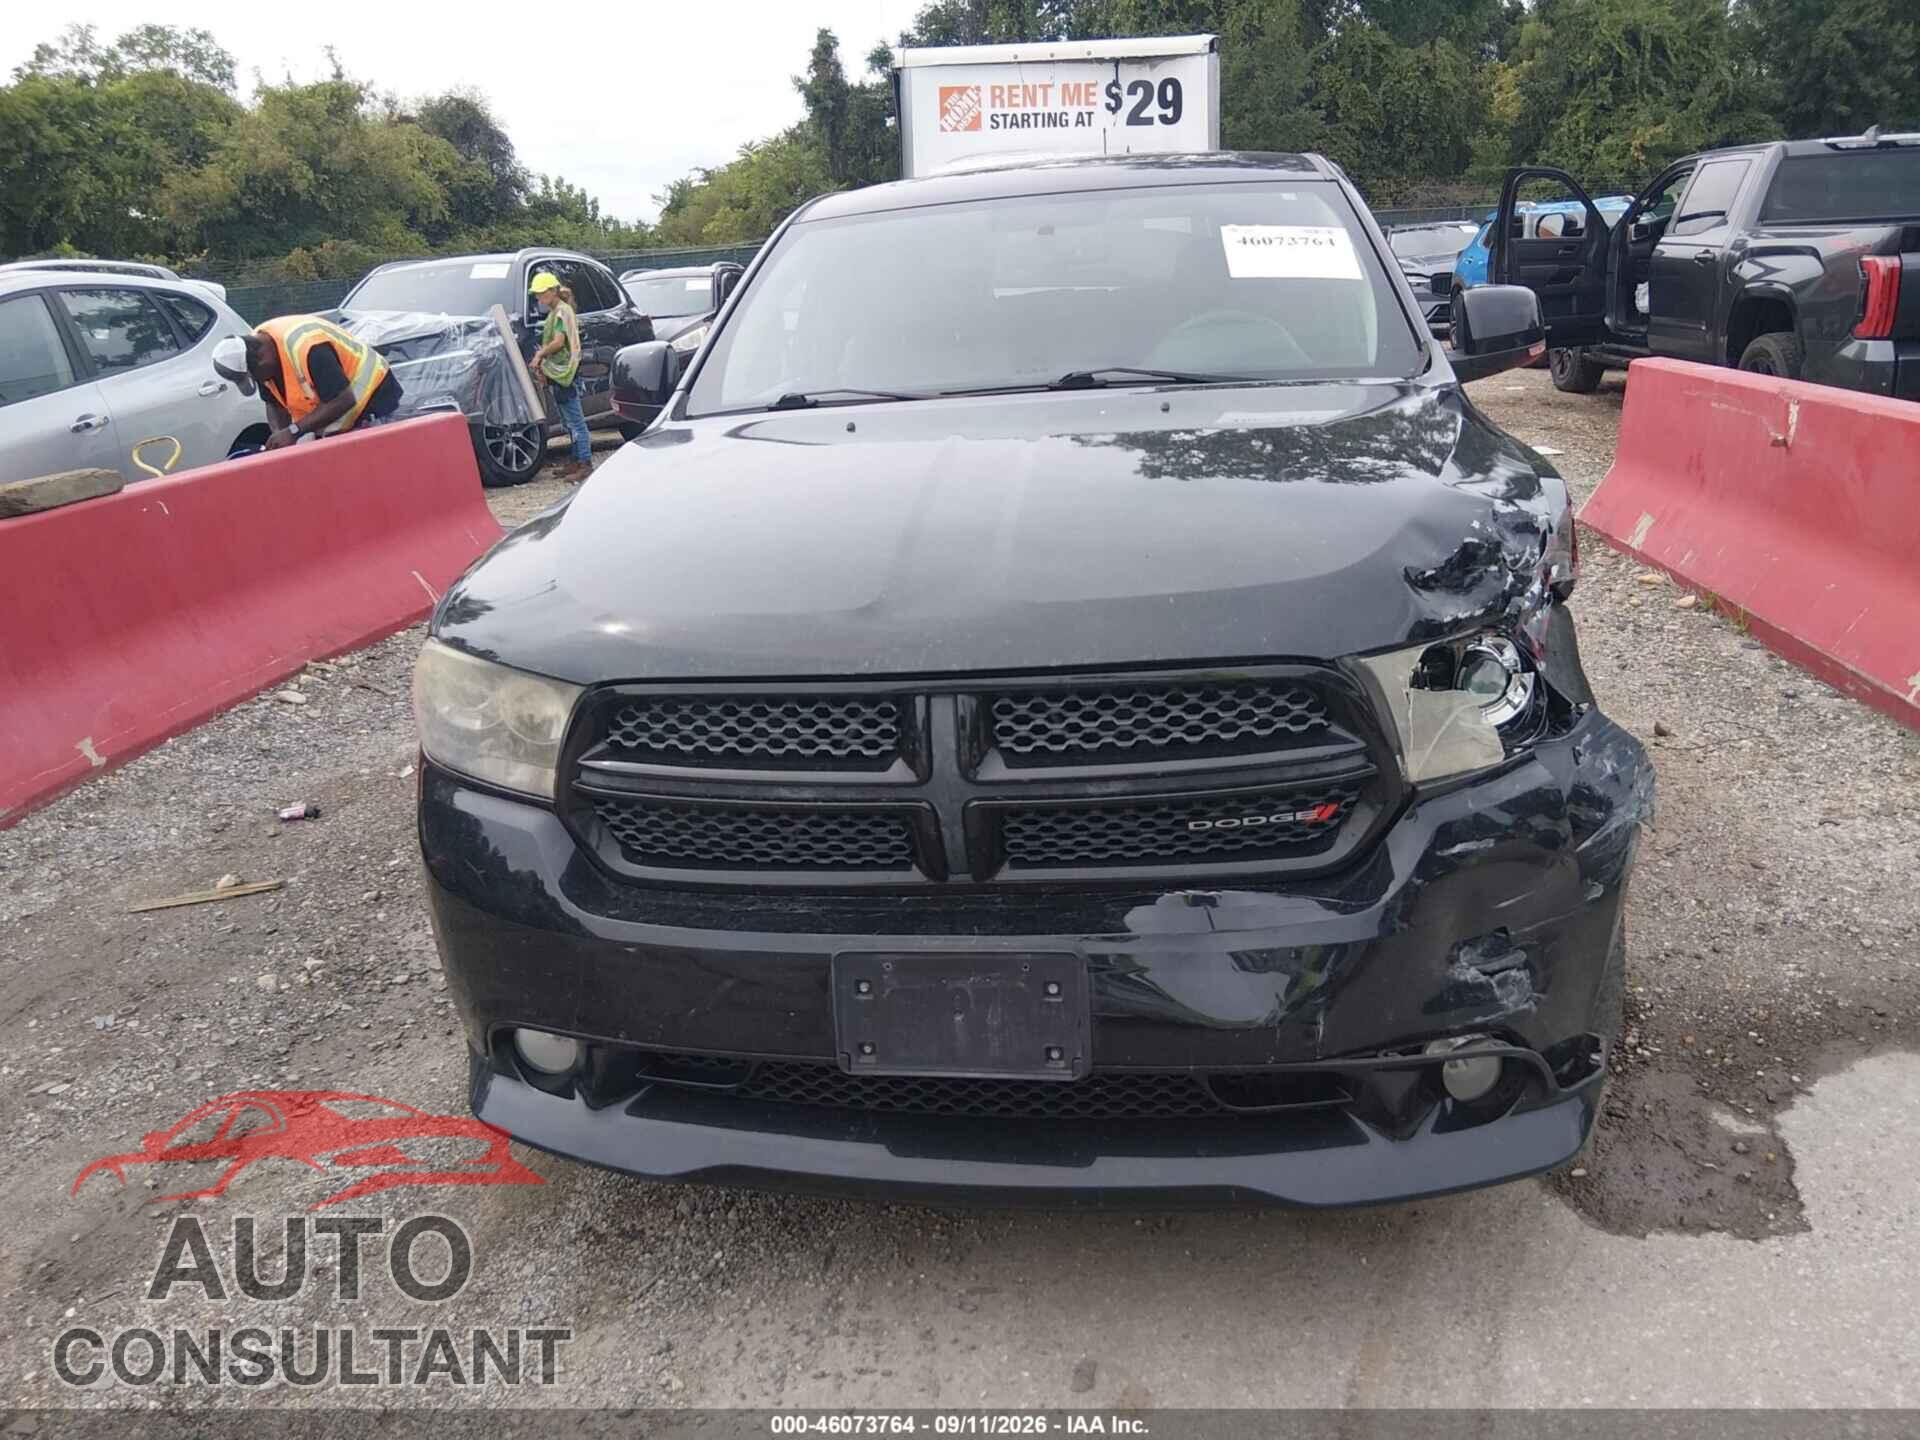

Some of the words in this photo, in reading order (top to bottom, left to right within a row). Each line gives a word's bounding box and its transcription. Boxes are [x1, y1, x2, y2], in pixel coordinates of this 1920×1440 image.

[990, 84, 1053, 109] RENT
[1061, 82, 1097, 107] ME
[1104, 77, 1183, 127] $29
[989, 112, 1069, 130] STARTING
[1075, 111, 1095, 128] AT
[1188, 810, 1318, 830] DODGE
